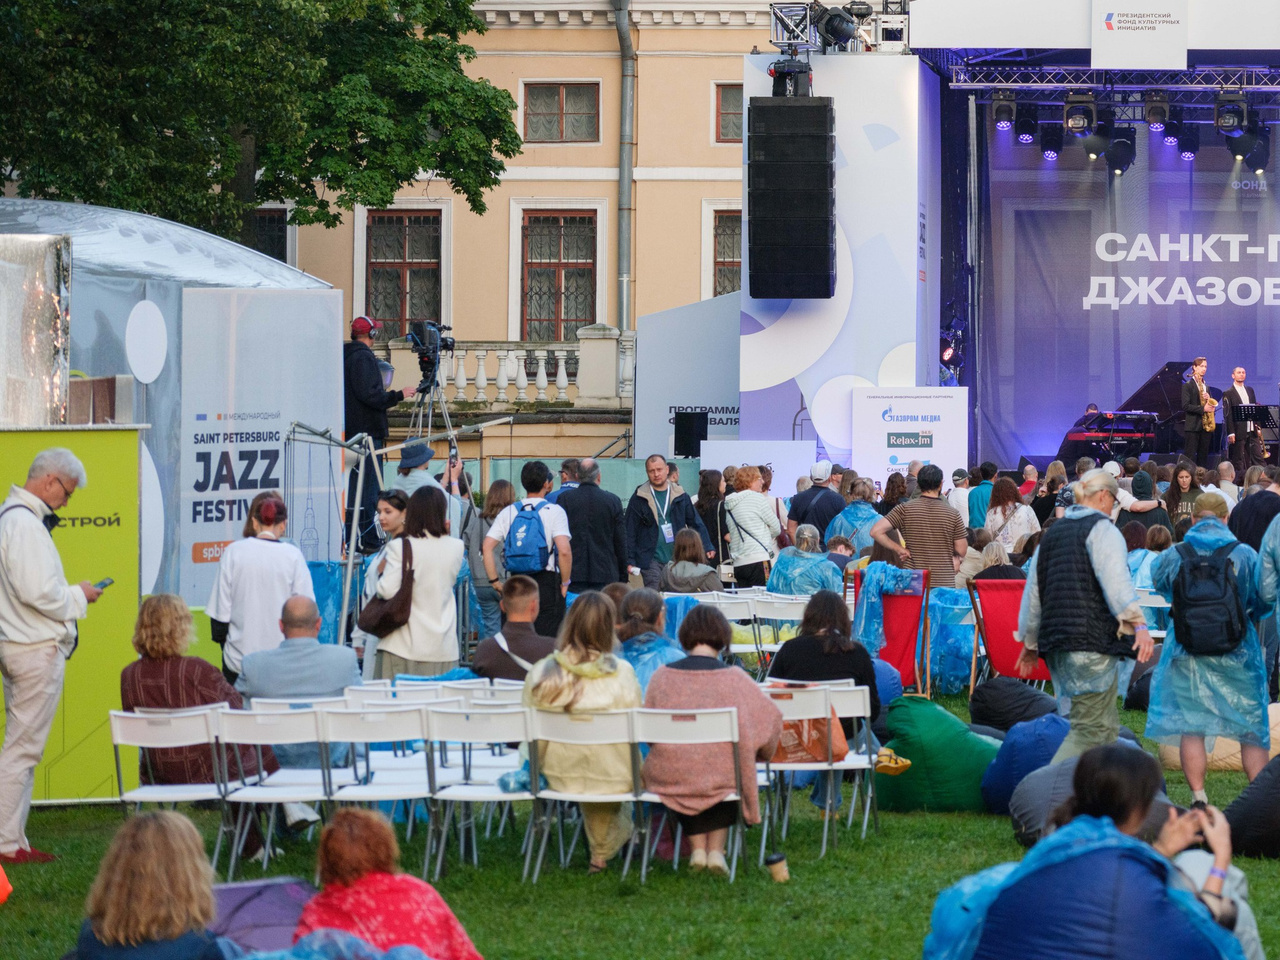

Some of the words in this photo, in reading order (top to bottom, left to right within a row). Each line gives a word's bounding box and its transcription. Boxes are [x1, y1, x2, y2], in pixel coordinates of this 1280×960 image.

[1231, 180, 1267, 191] ФОНД
[668, 417, 740, 425] ФВАЛЯ
[194, 433, 220, 444] SAINT
[223, 431, 280, 443] PETERSBURG
[890, 436, 930, 445] Relax-fm
[193, 449, 280, 492] JAZZ
[56, 512, 120, 528] СТРОЙ
